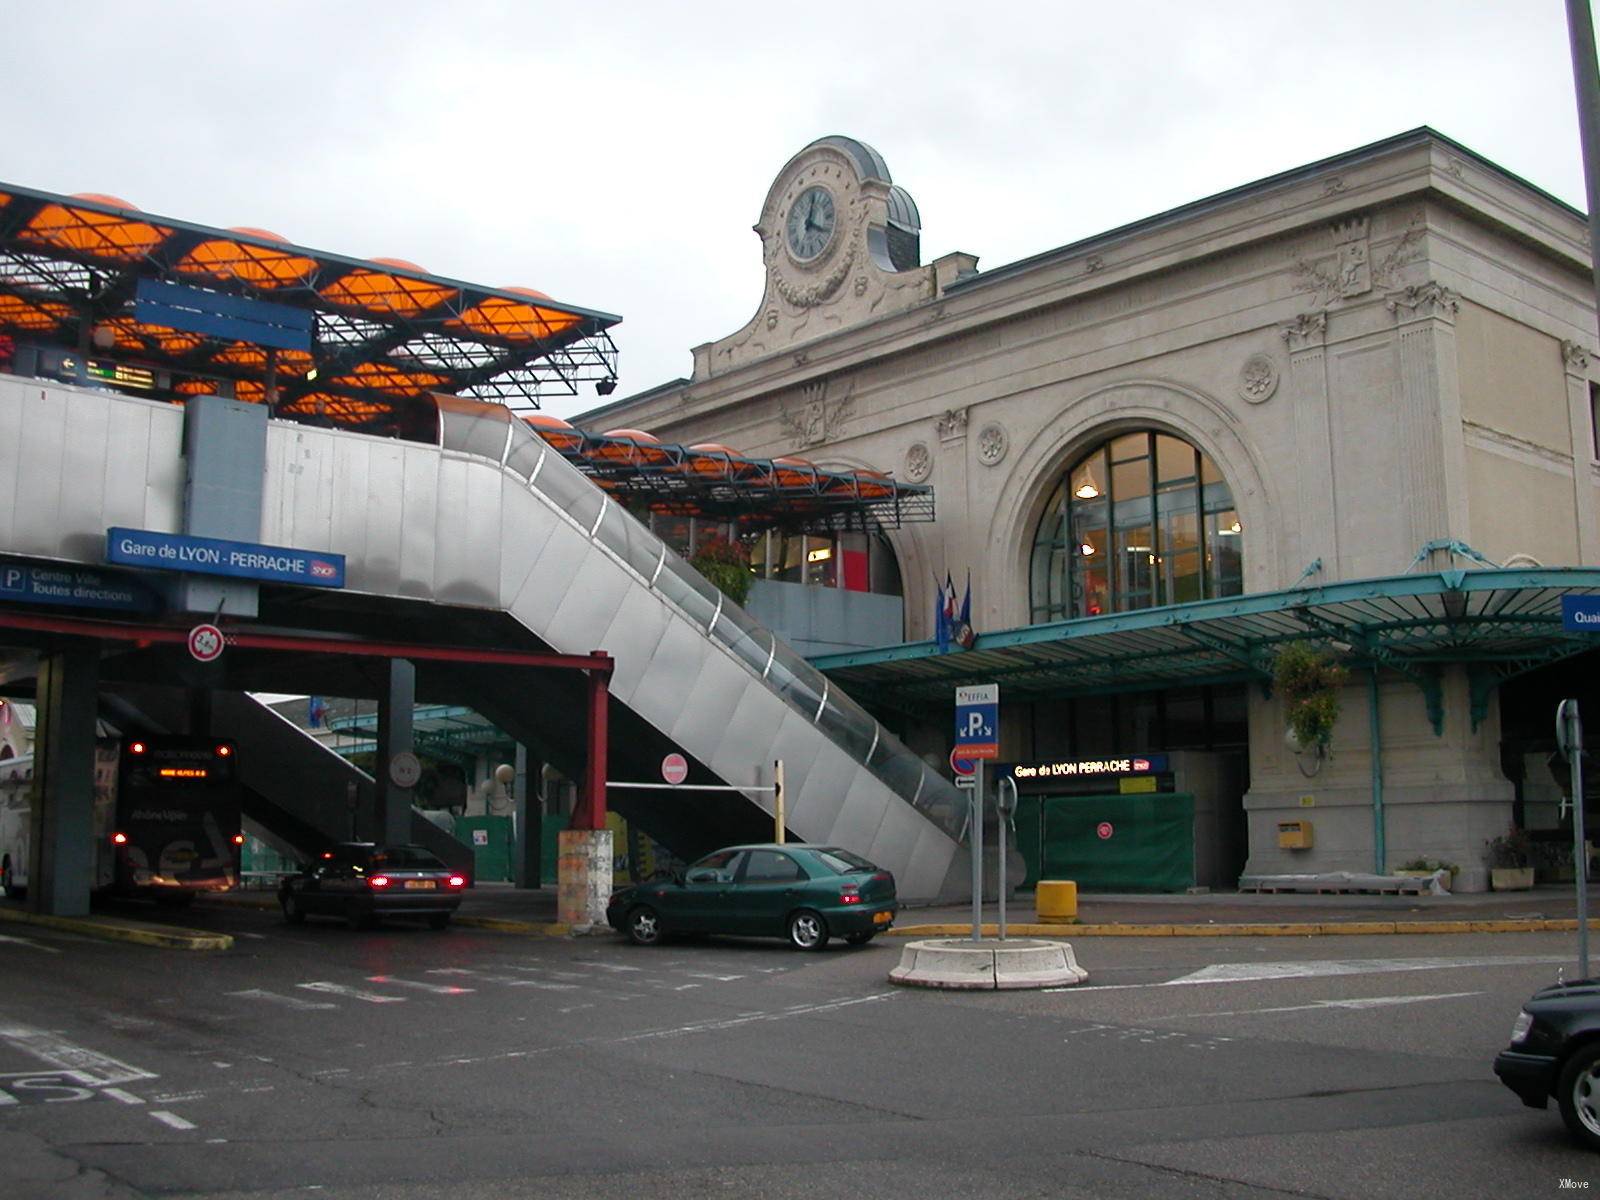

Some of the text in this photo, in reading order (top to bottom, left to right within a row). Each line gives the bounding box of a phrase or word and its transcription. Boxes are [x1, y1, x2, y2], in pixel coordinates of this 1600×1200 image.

[120, 539, 156, 556] Gare
[158, 544, 177, 559] de
[179, 547, 220, 564] LYON
[230, 552, 305, 573] PERRACHE
[7, 570, 20, 587] P
[31, 568, 72, 583] Centre
[32, 582, 134, 603] Toutes directions
[967, 692, 989, 702] EFFIA
[969, 712, 983, 737] P
[1014, 765, 1037, 777] Gare
[1039, 765, 1051, 776] de
[1052, 763, 1077, 775] LYON
[1079, 759, 1130, 773] PERRACHE
